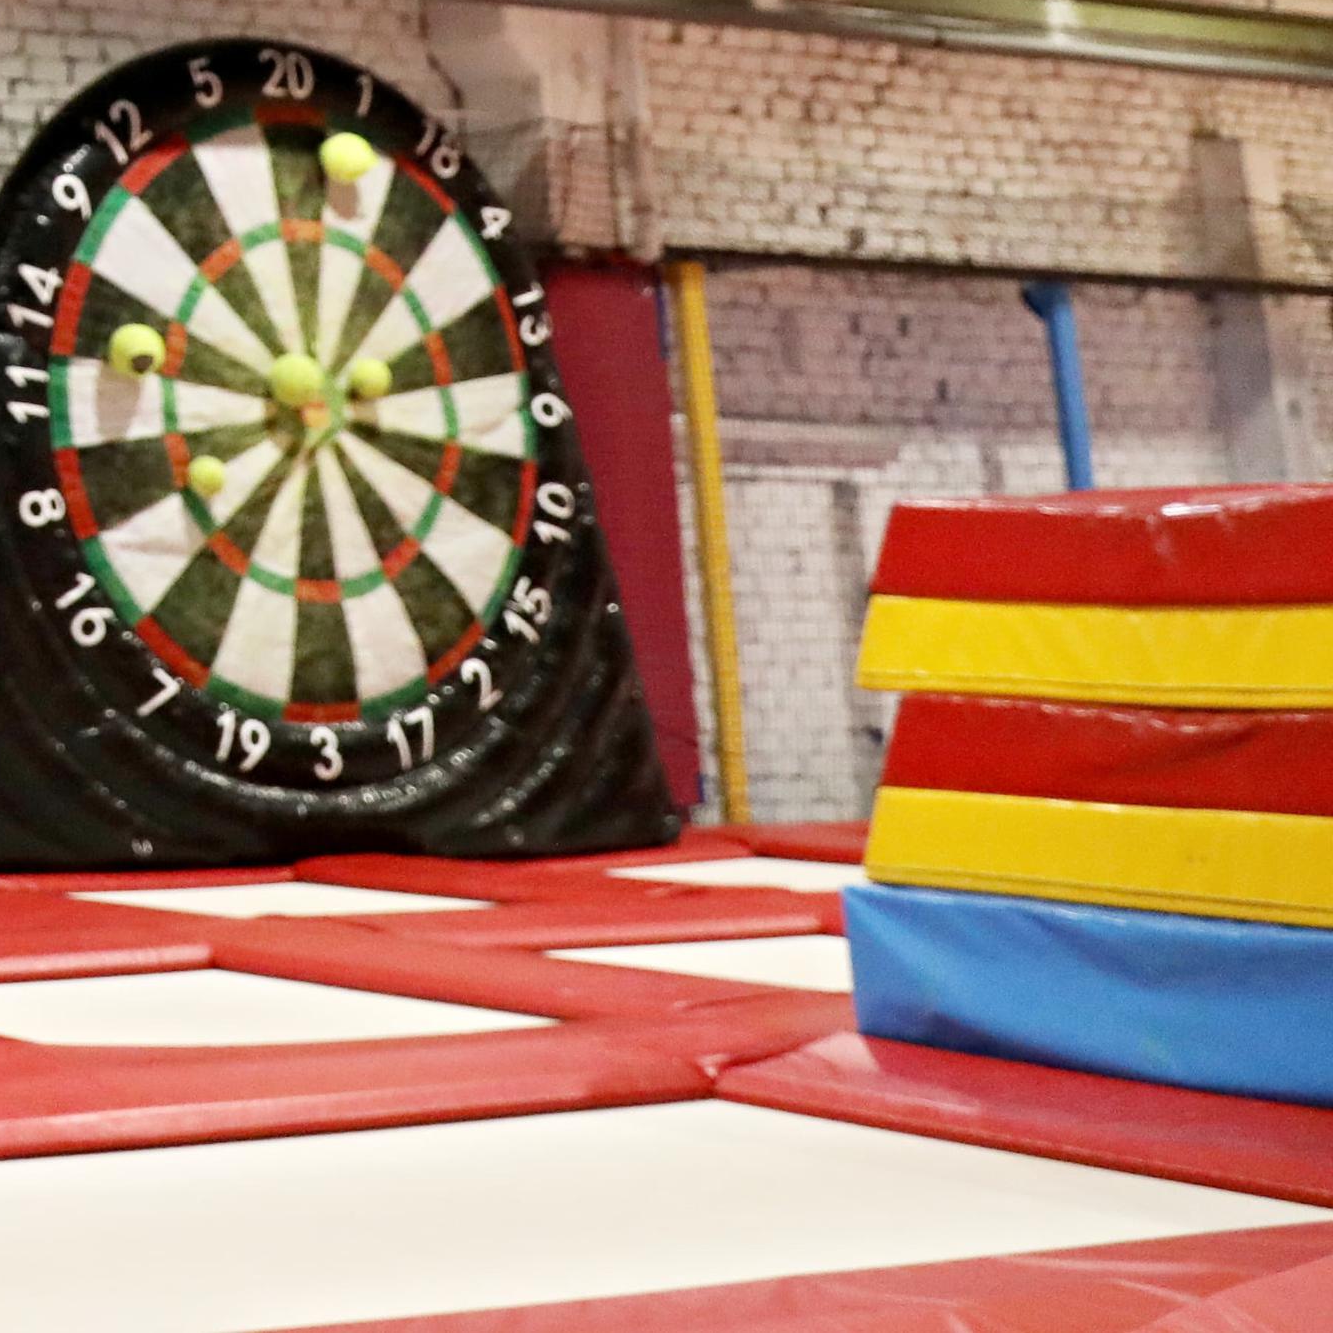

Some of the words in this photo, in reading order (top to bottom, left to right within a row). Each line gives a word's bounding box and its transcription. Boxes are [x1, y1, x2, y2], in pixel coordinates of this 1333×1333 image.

[187, 57, 223, 108] 5
[259, 48, 315, 100] 20
[357, 74, 374, 116] 1
[95, 99, 153, 165] 12
[416, 117, 460, 179] 18
[52, 173, 92, 221] 9
[480, 206, 512, 240] 4
[6, 263, 64, 328] 14
[512, 281, 553, 346] 13
[5, 365, 50, 424] 11
[19, 488, 66, 527] 8
[533, 481, 575, 544] 10
[55, 572, 116, 647] 16
[503, 574, 553, 644] 15
[136, 667, 181, 716] 7
[460, 657, 504, 711] 2
[216, 709, 271, 772] 19
[310, 725, 343, 781] 3
[386, 706, 435, 771] 17
